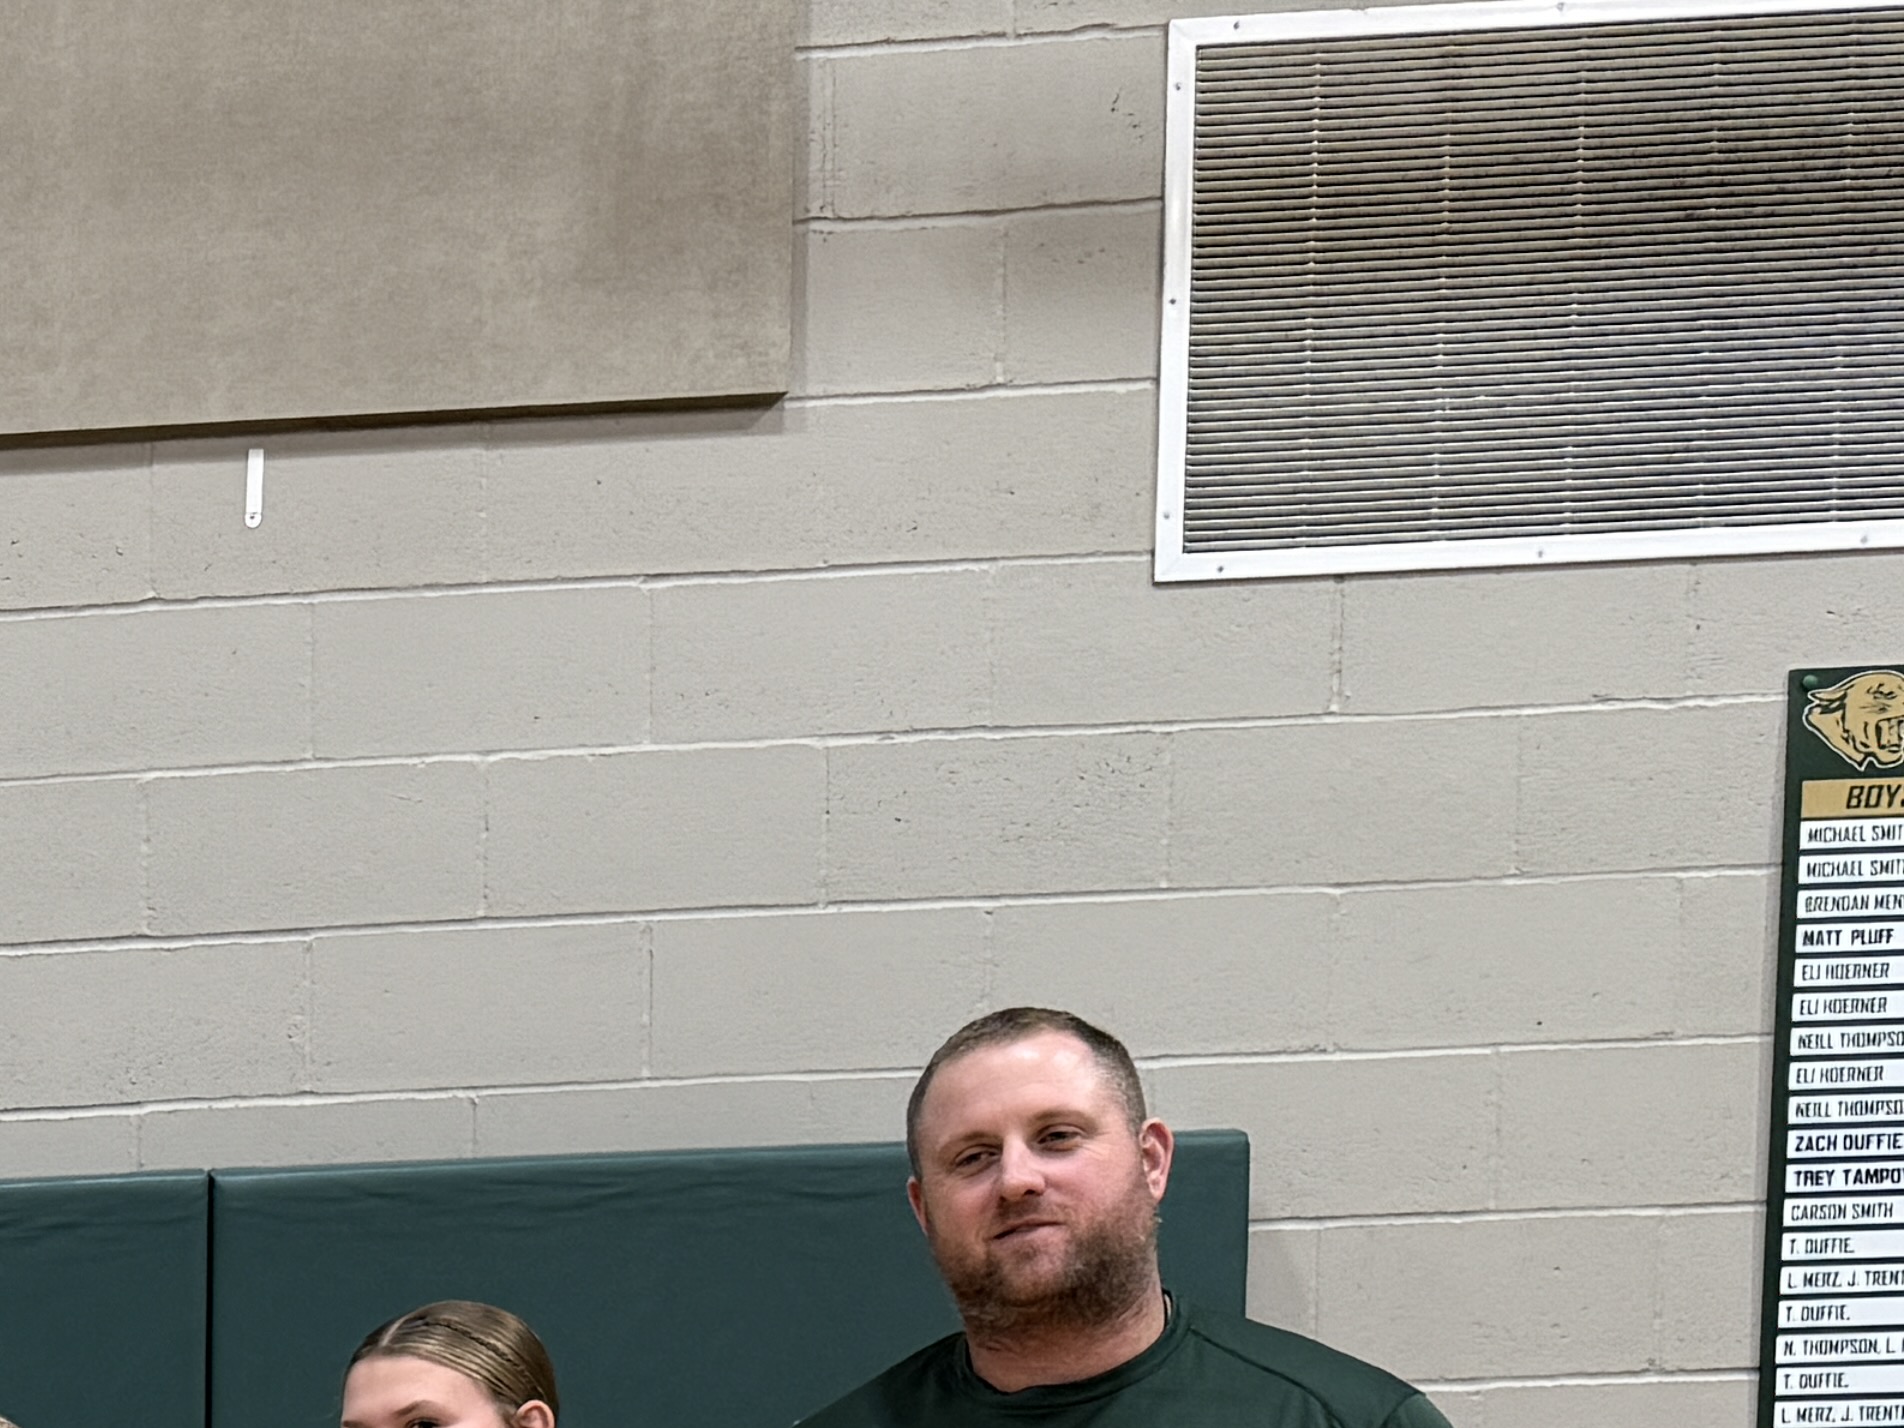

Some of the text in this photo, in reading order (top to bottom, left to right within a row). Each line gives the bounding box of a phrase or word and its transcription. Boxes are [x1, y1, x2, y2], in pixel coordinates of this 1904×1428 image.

[1845, 784, 1904, 810] BOY
[1807, 823, 1904, 843] MICHAEL SMIT
[1806, 858, 1904, 878] MICHAEL SMIT
[1804, 893, 1904, 913] BRENDAN MEN
[1802, 928, 1895, 946] MATT PLUFF
[1825, 962, 1890, 980] HOERNER
[1822, 996, 1888, 1014] HOERNER
[1797, 1030, 1904, 1050] NEILL THOMPSO
[1819, 1065, 1884, 1083] HOERNER
[1795, 1098, 1904, 1118] NEILL THOMPSO
[1794, 1133, 1838, 1152] ZACH
[1793, 1167, 1904, 1187] TREY TAMPO
[1791, 1202, 1894, 1221] CARSON SMITH
[1858, 1404, 1904, 1421] TRENT
